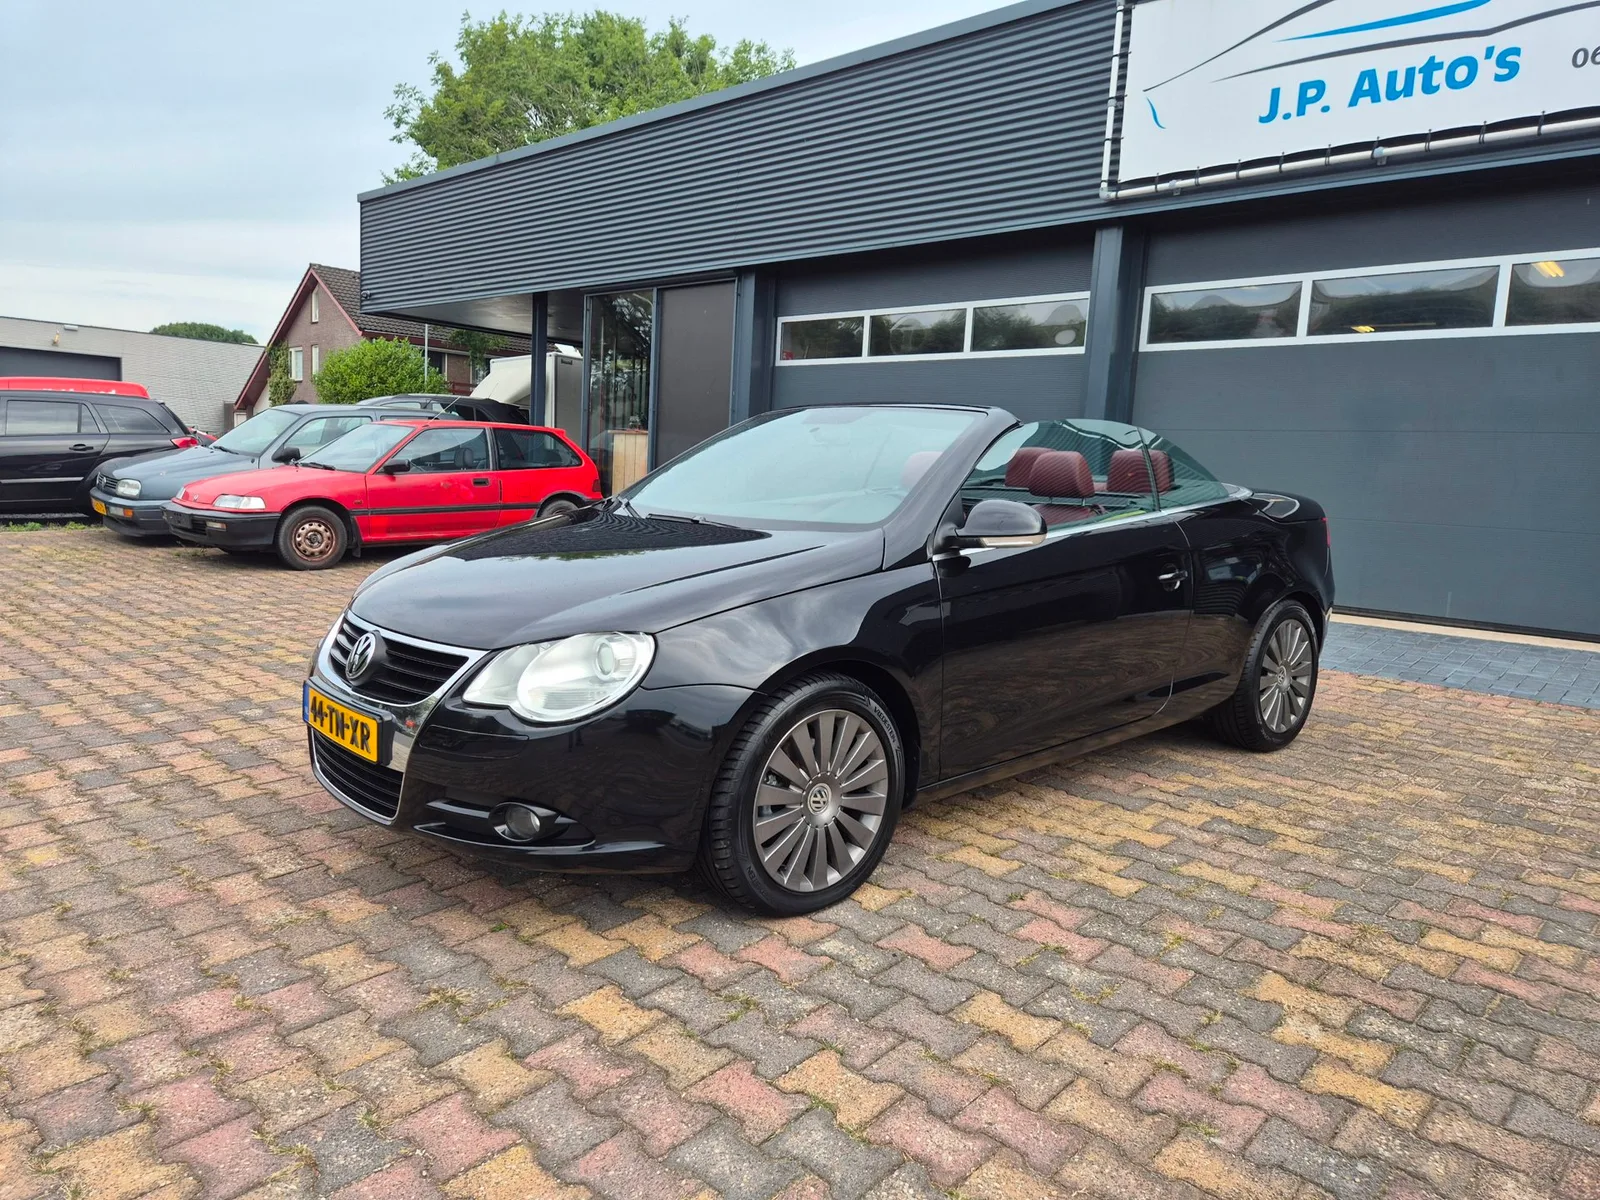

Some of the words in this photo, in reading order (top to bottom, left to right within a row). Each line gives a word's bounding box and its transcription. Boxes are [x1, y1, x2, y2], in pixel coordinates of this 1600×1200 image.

[1258, 80, 1331, 124] J.P.
[1347, 45, 1522, 108] Auto's
[311, 696, 371, 754] 44-TN-XR
